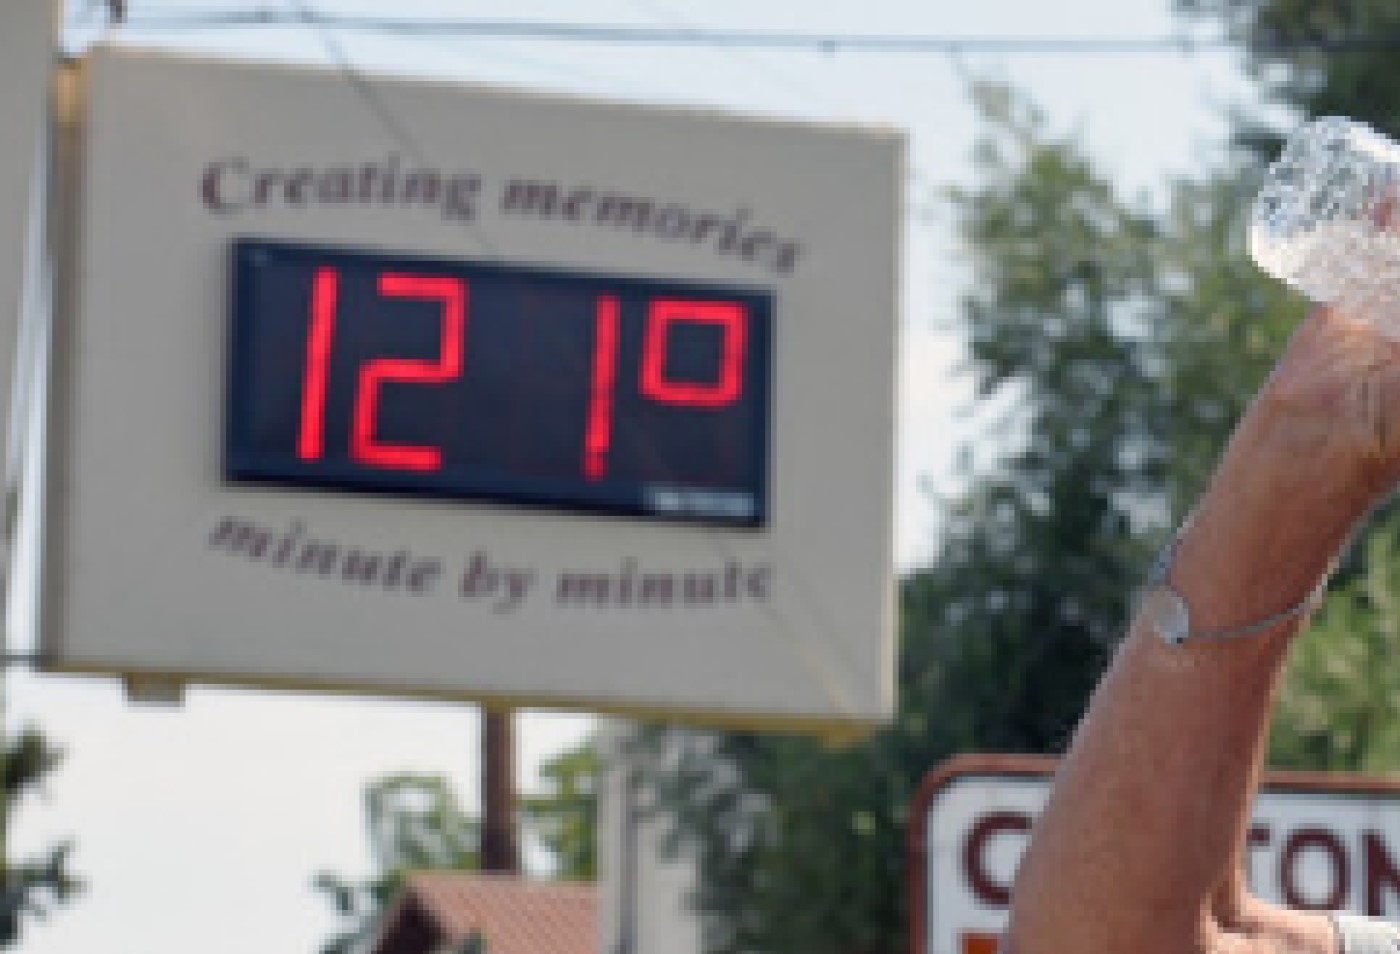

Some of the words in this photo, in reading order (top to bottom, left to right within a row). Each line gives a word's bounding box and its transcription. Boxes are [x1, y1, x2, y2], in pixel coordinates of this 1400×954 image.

[202, 154, 481, 222] Creating
[505, 179, 799, 274] memories
[208, 516, 442, 597] minute
[458, 548, 538, 615] by
[557, 556, 771, 608] minute
